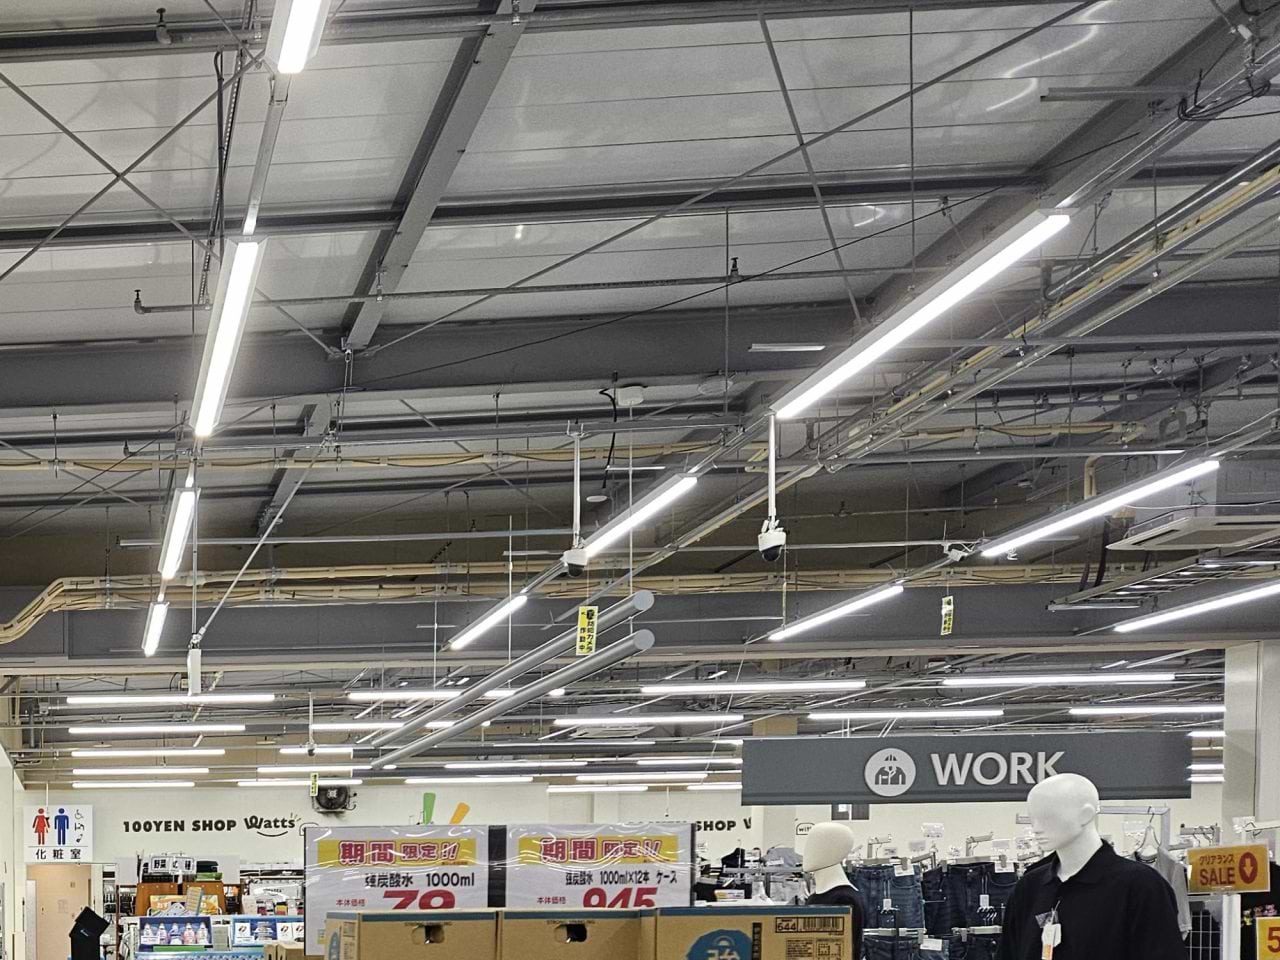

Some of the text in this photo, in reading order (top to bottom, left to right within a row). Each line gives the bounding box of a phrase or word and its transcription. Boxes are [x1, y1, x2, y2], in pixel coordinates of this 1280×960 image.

[930, 751, 1065, 786] WORK
[123, 815, 295, 832] 100YEN SHOP Watts
[35, 848, 81, 860] 化粧室
[1200, 854, 1235, 865] クリアランス
[426, 872, 475, 887] 1000ml
[1200, 867, 1236, 886] SALE
[582, 887, 658, 908] 945
